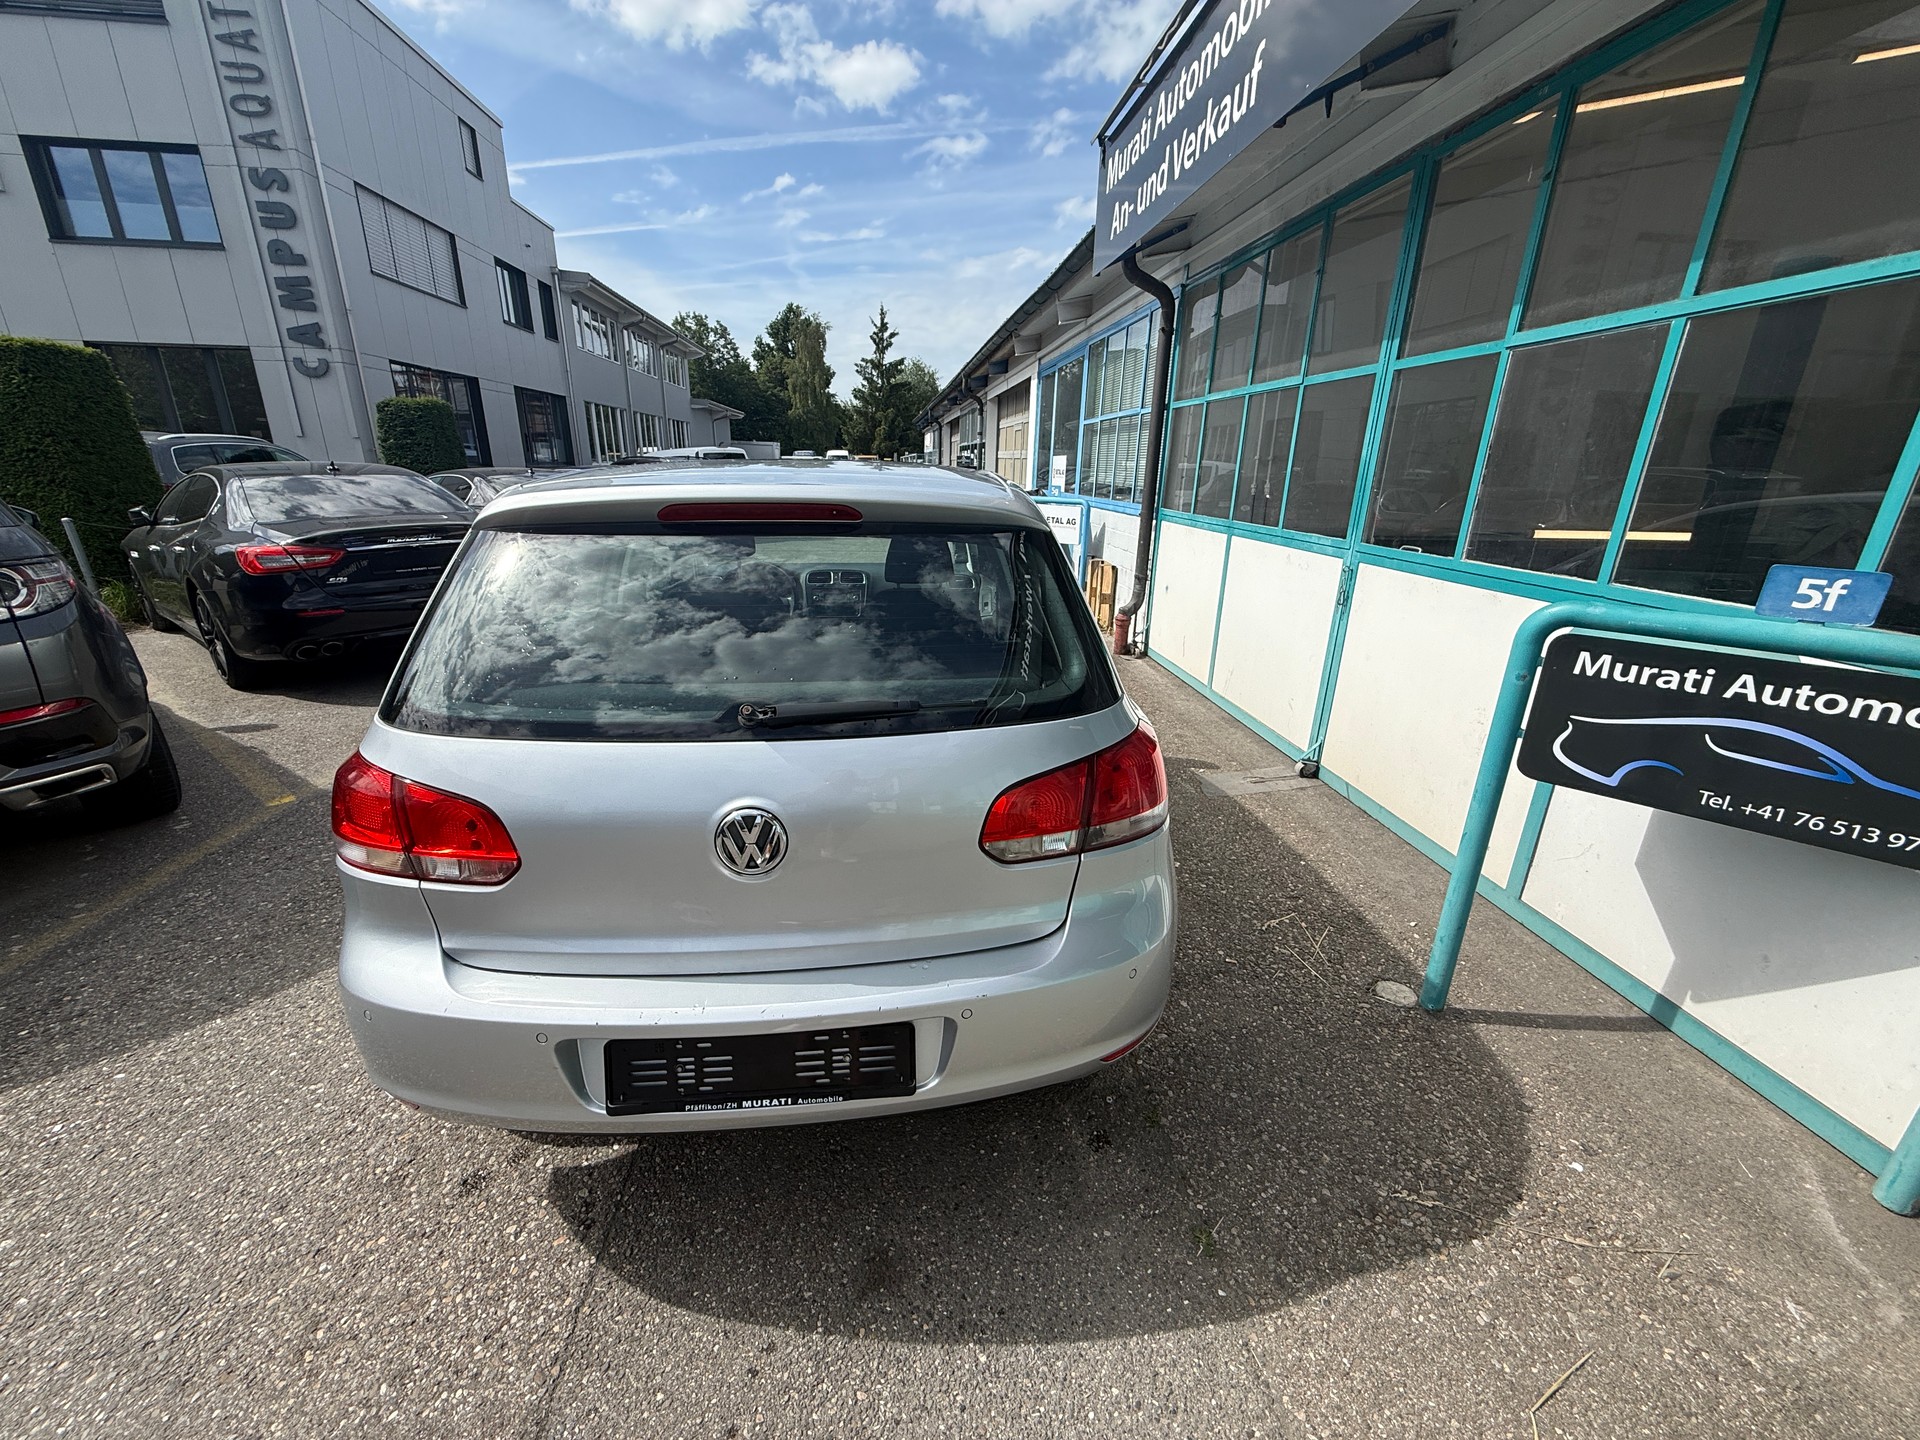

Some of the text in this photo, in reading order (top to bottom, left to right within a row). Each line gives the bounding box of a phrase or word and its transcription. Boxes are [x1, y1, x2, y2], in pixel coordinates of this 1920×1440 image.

[1106, 0, 1271, 195] Murati Automob
[1110, 38, 1266, 241] An- und Verkauf
[206, 1, 330, 379] CAMPUS AQUAT
[1065, 518, 1077, 526] AG
[1791, 577, 1852, 611] 5f
[1572, 650, 1717, 695] Murati
[715, 808, 788, 874] VW
[1699, 790, 1920, 851] Tel. +41 76 513 97
[685, 1095, 844, 1111] Pfäffikon/ZH MURATI Automobile
